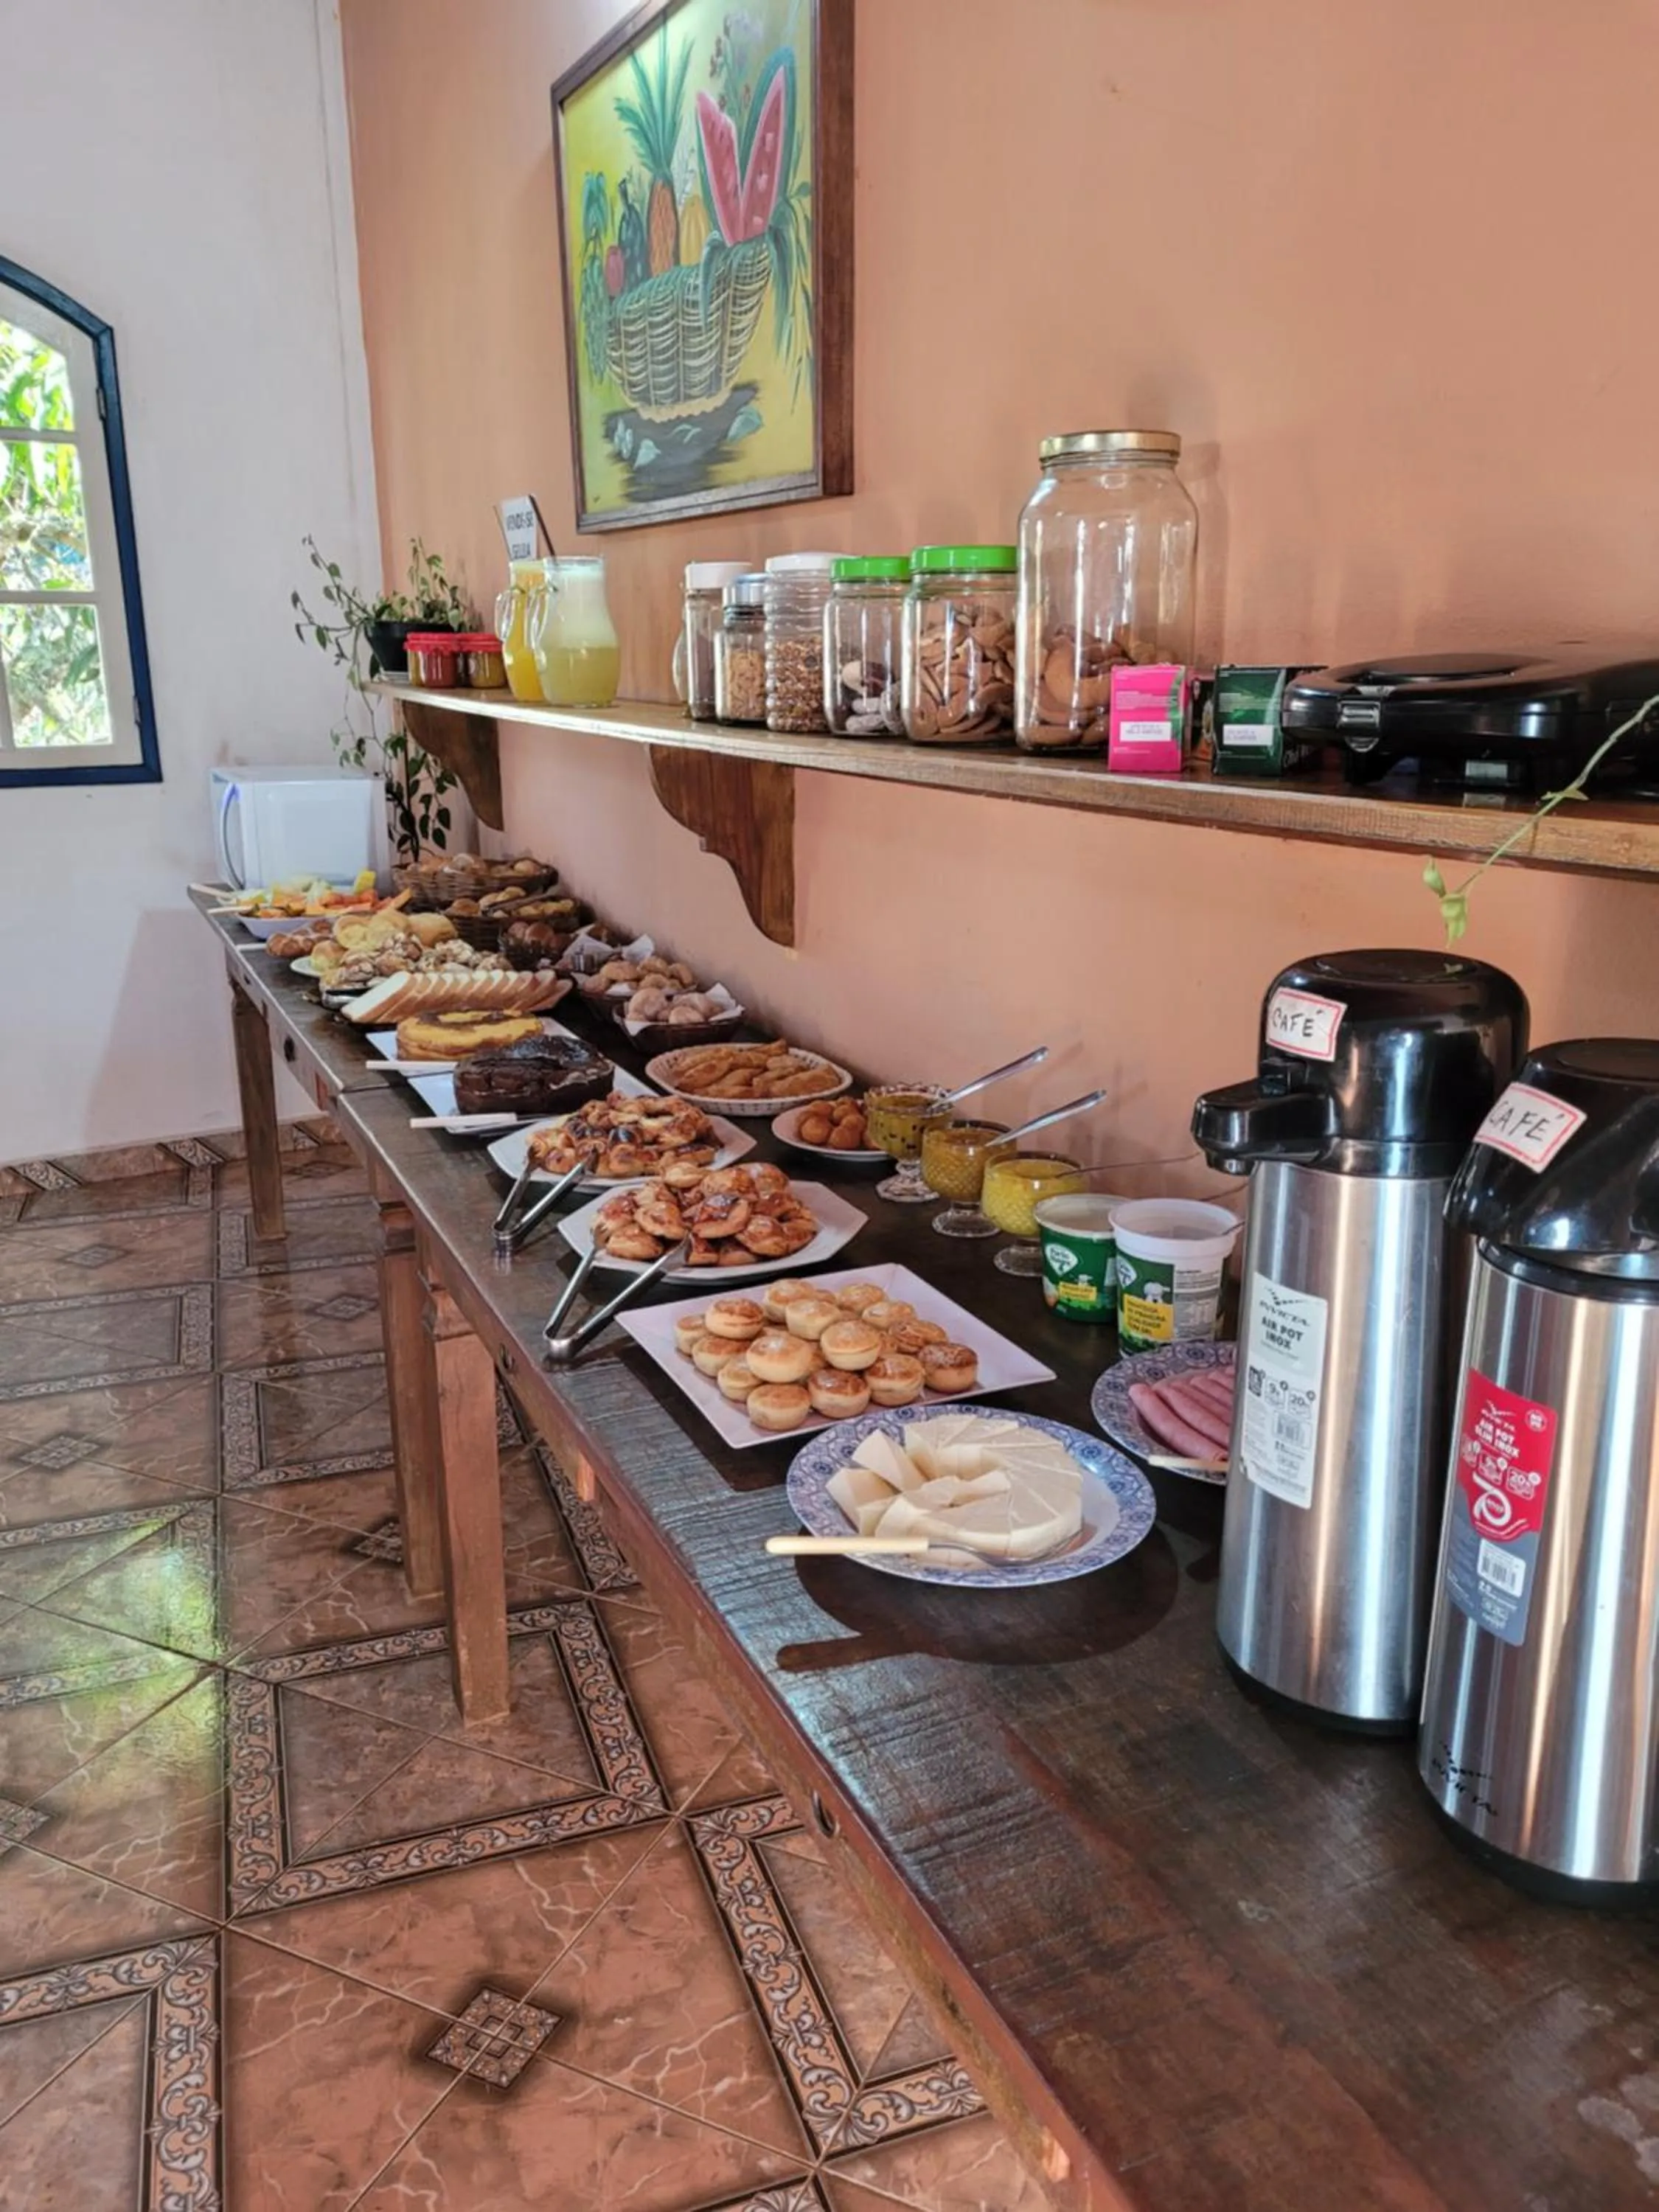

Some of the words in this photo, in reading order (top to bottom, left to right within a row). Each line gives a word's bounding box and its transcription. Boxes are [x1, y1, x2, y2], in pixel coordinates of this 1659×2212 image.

[1272, 1007, 1324, 1037] CAFÉ
[1489, 1101, 1565, 1141] CAFÉ
[1262, 1316, 1278, 1332] AIR
[1279, 1325, 1304, 1341] POT
[1265, 1329, 1291, 1350] INOX
[1495, 1428, 1514, 1445] POT
[1494, 1439, 1520, 1459] INOX
